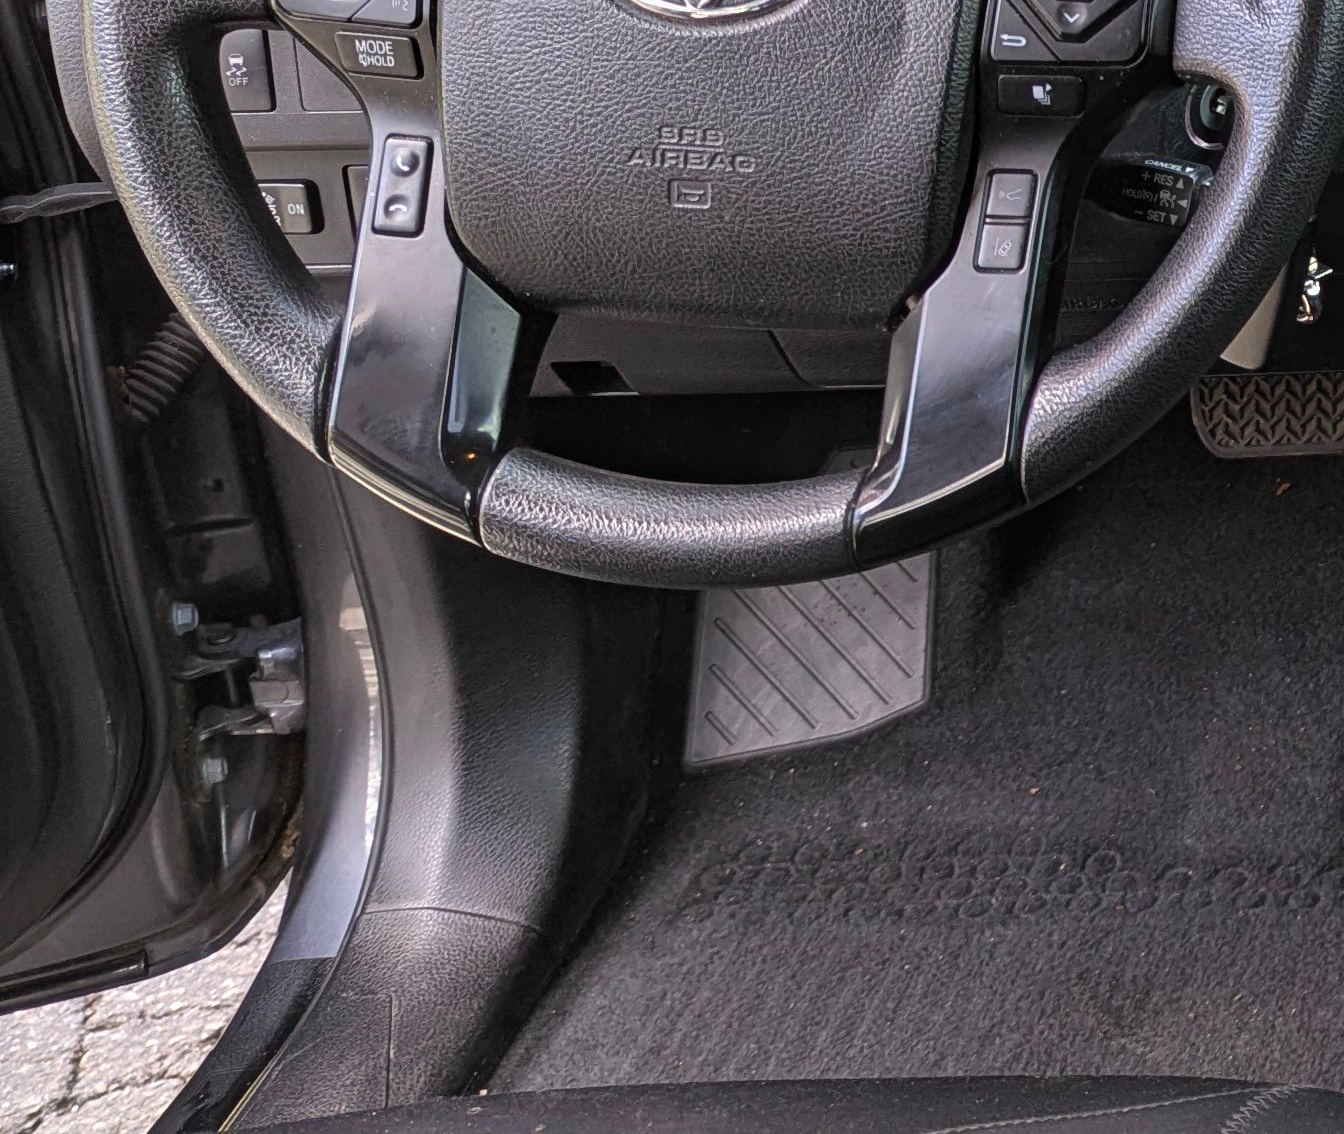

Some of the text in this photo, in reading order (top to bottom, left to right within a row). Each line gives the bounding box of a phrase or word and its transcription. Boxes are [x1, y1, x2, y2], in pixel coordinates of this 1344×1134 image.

[355, 40, 393, 55] MODE
[368, 56, 394, 66] HOLD
[228, 78, 248, 87] OFF
[659, 126, 724, 146] SRS
[626, 147, 756, 173] AIRBAG
[1154, 173, 1174, 186] RES
[287, 204, 304, 215] ON
[1147, 210, 1167, 223] SET
